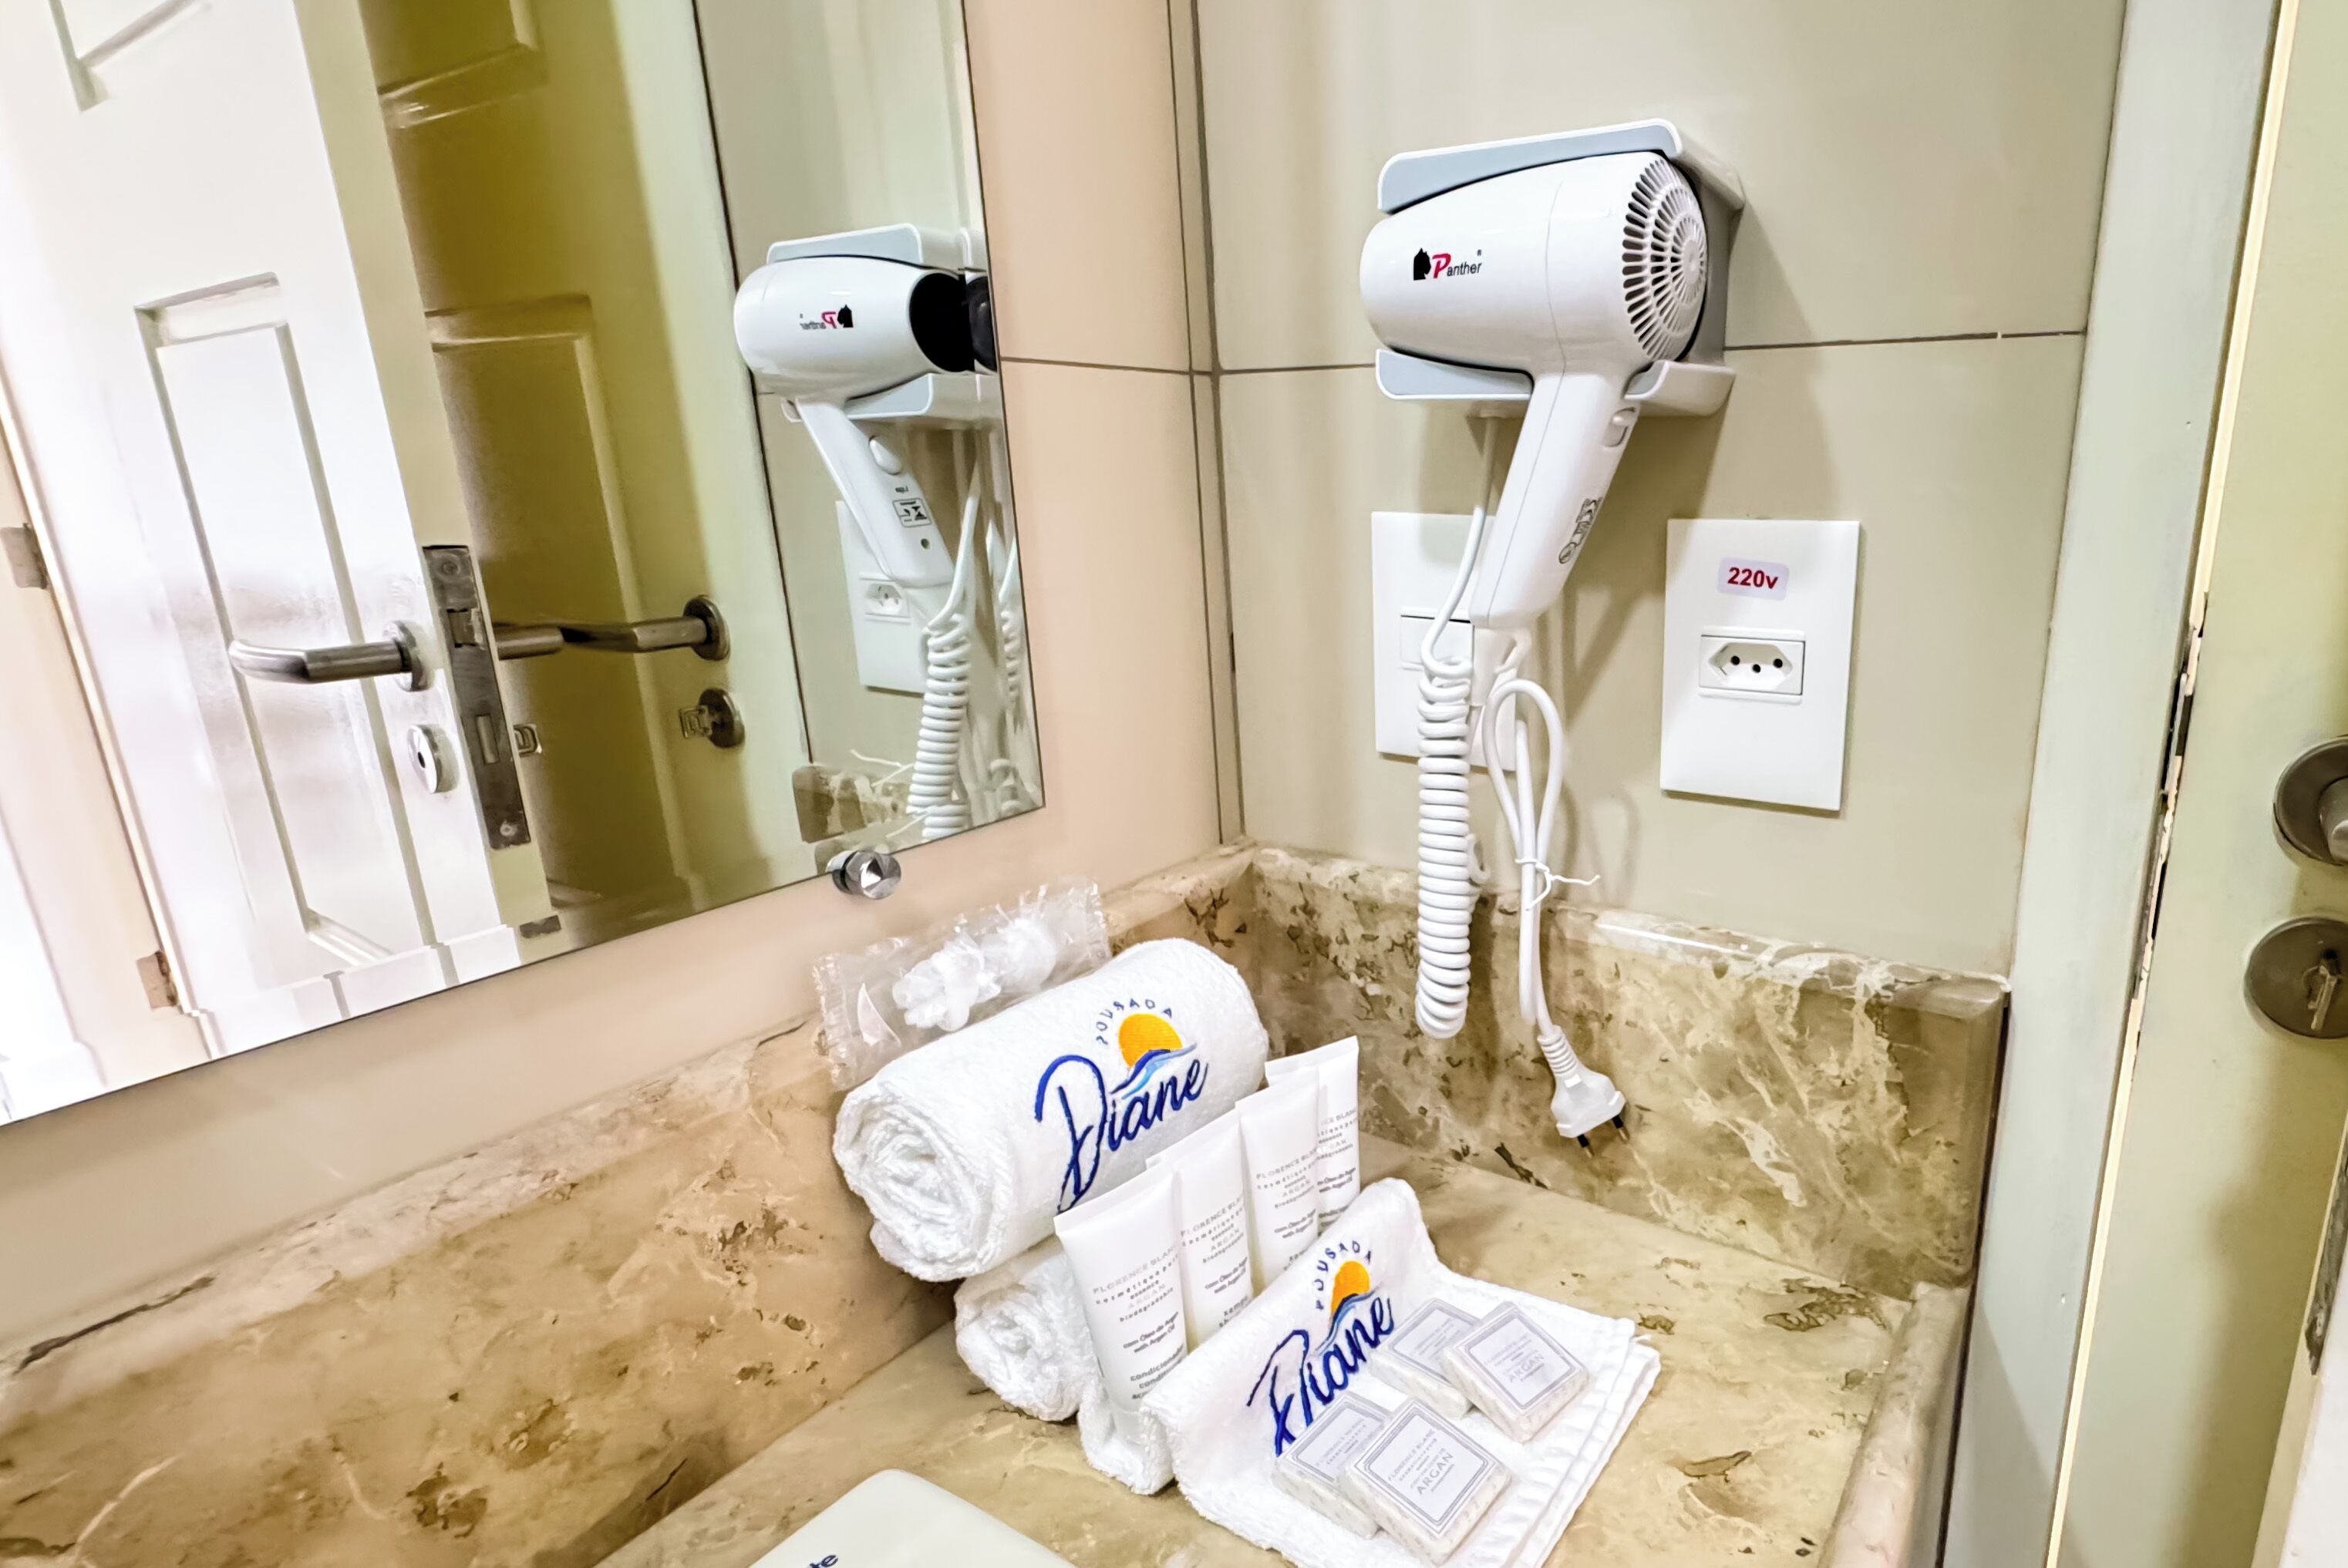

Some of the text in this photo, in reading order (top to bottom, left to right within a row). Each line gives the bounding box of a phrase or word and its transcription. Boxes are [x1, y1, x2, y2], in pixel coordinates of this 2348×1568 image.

[1432, 253, 1482, 279] Panther
[1727, 567, 1779, 590] 220v
[1096, 998, 1173, 1045] POUSADA
[1034, 1054, 1209, 1216] Diane
[1414, 1452, 1454, 1495] ARGAN
